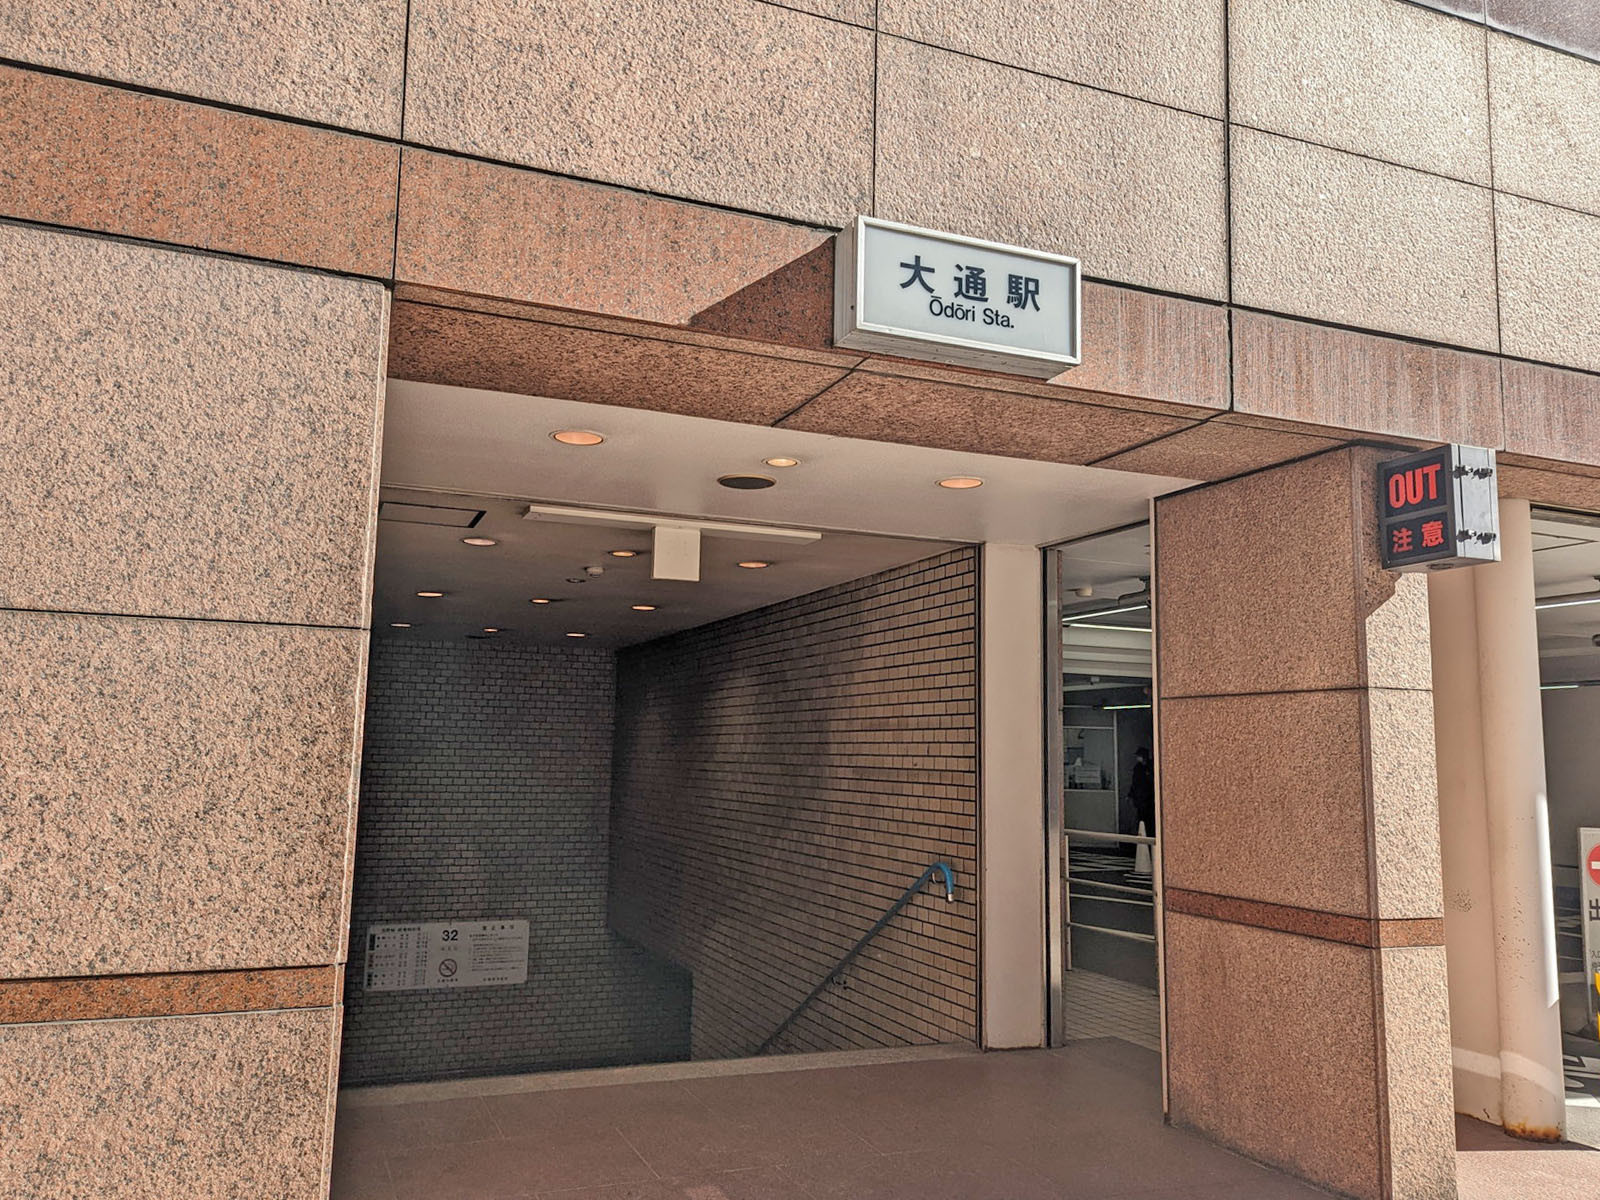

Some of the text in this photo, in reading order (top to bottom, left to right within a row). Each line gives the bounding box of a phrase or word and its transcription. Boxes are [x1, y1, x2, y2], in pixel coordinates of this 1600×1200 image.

[899, 255, 1041, 312] 大通駅
[929, 295, 1015, 329] Ōdōri Sta.
[1388, 463, 1441, 509] OUT
[1392, 521, 1445, 553] 注意
[442, 929, 459, 942] 32
